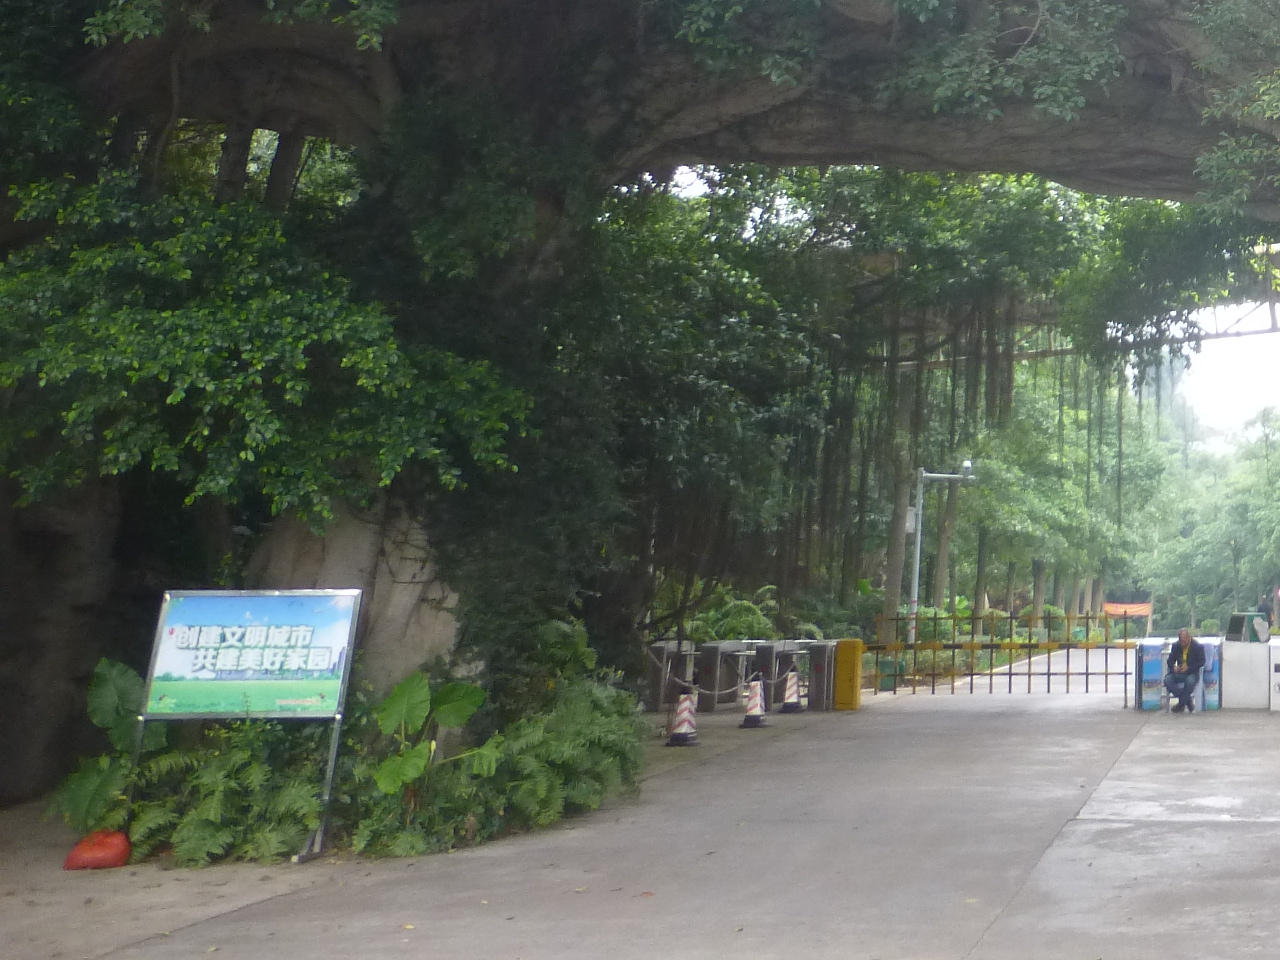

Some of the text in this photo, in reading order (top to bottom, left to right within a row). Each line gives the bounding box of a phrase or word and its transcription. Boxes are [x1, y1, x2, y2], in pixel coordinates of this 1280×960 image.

[177, 625, 314, 648] 创建文明城市
[192, 647, 332, 672] 共建美好家园
